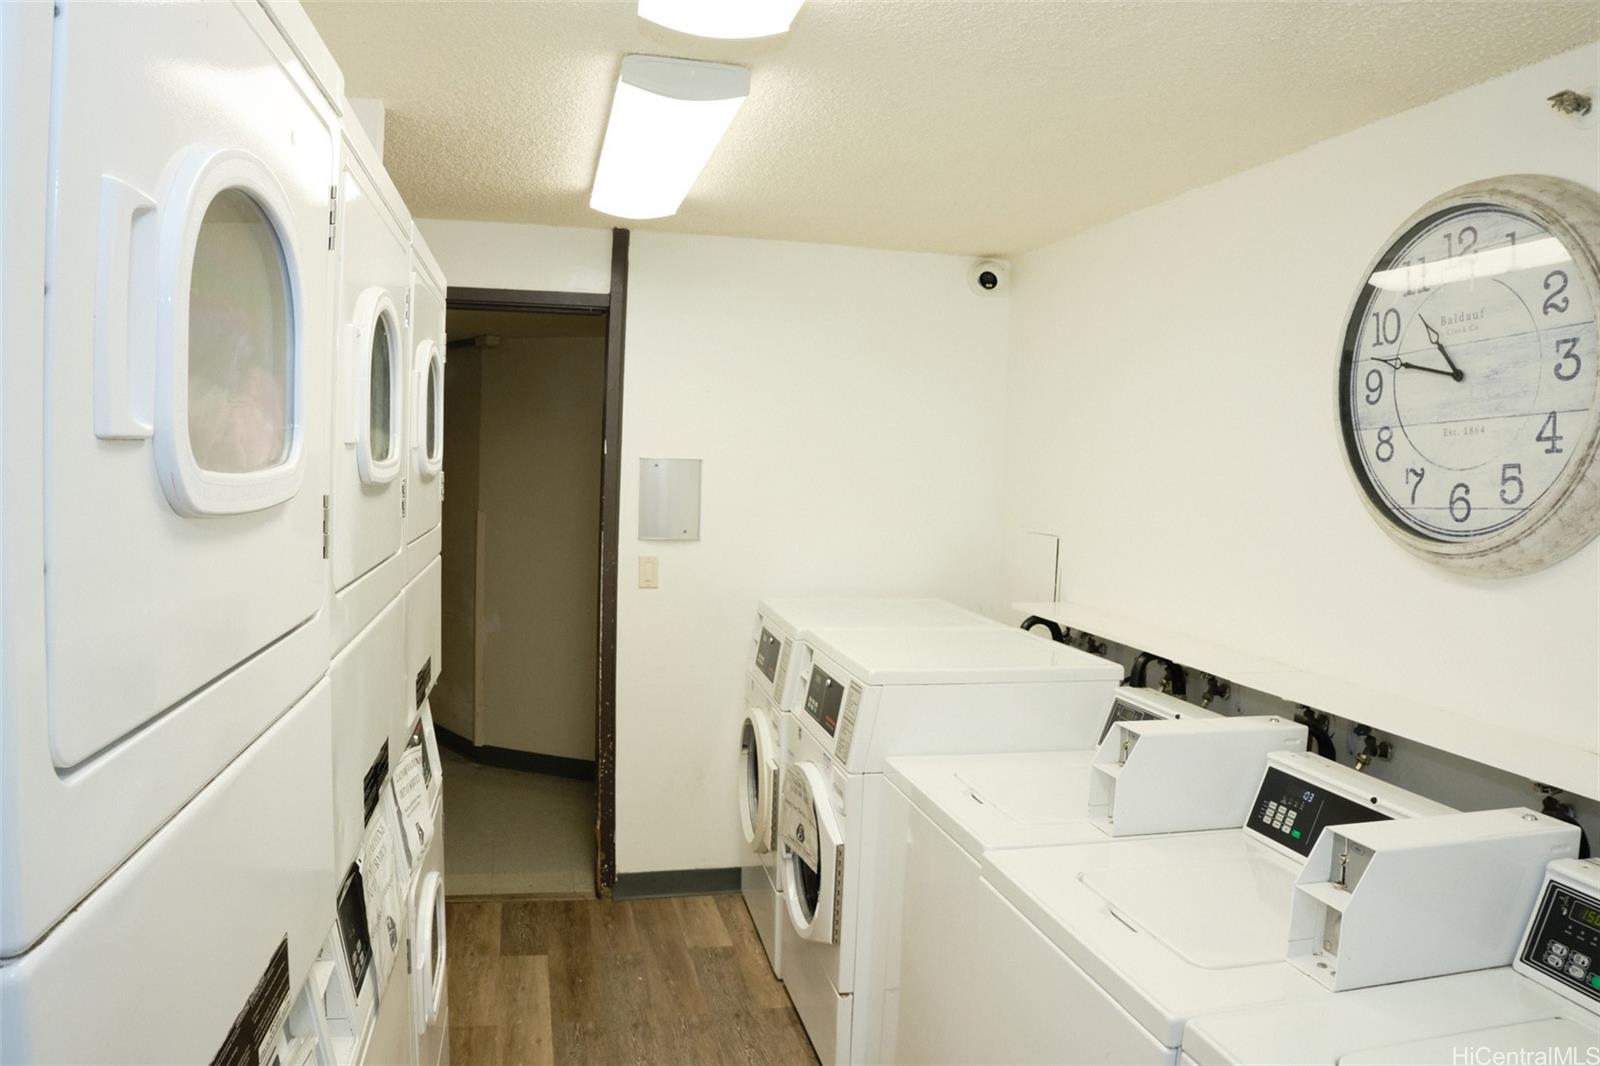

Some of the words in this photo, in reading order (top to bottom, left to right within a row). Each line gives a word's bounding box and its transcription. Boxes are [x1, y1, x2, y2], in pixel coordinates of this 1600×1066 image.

[1543, 270, 1569, 316] 2
[1372, 308, 1401, 347] 10
[1440, 307, 1486, 326] Baldauf
[1553, 337, 1582, 381] 3
[1365, 369, 1384, 405] 9
[1375, 426, 1395, 463] 8
[1535, 411, 1564, 454] 4
[1405, 467, 1425, 505] 7
[1449, 483, 1471, 523] 6
[1499, 463, 1524, 505] 5
